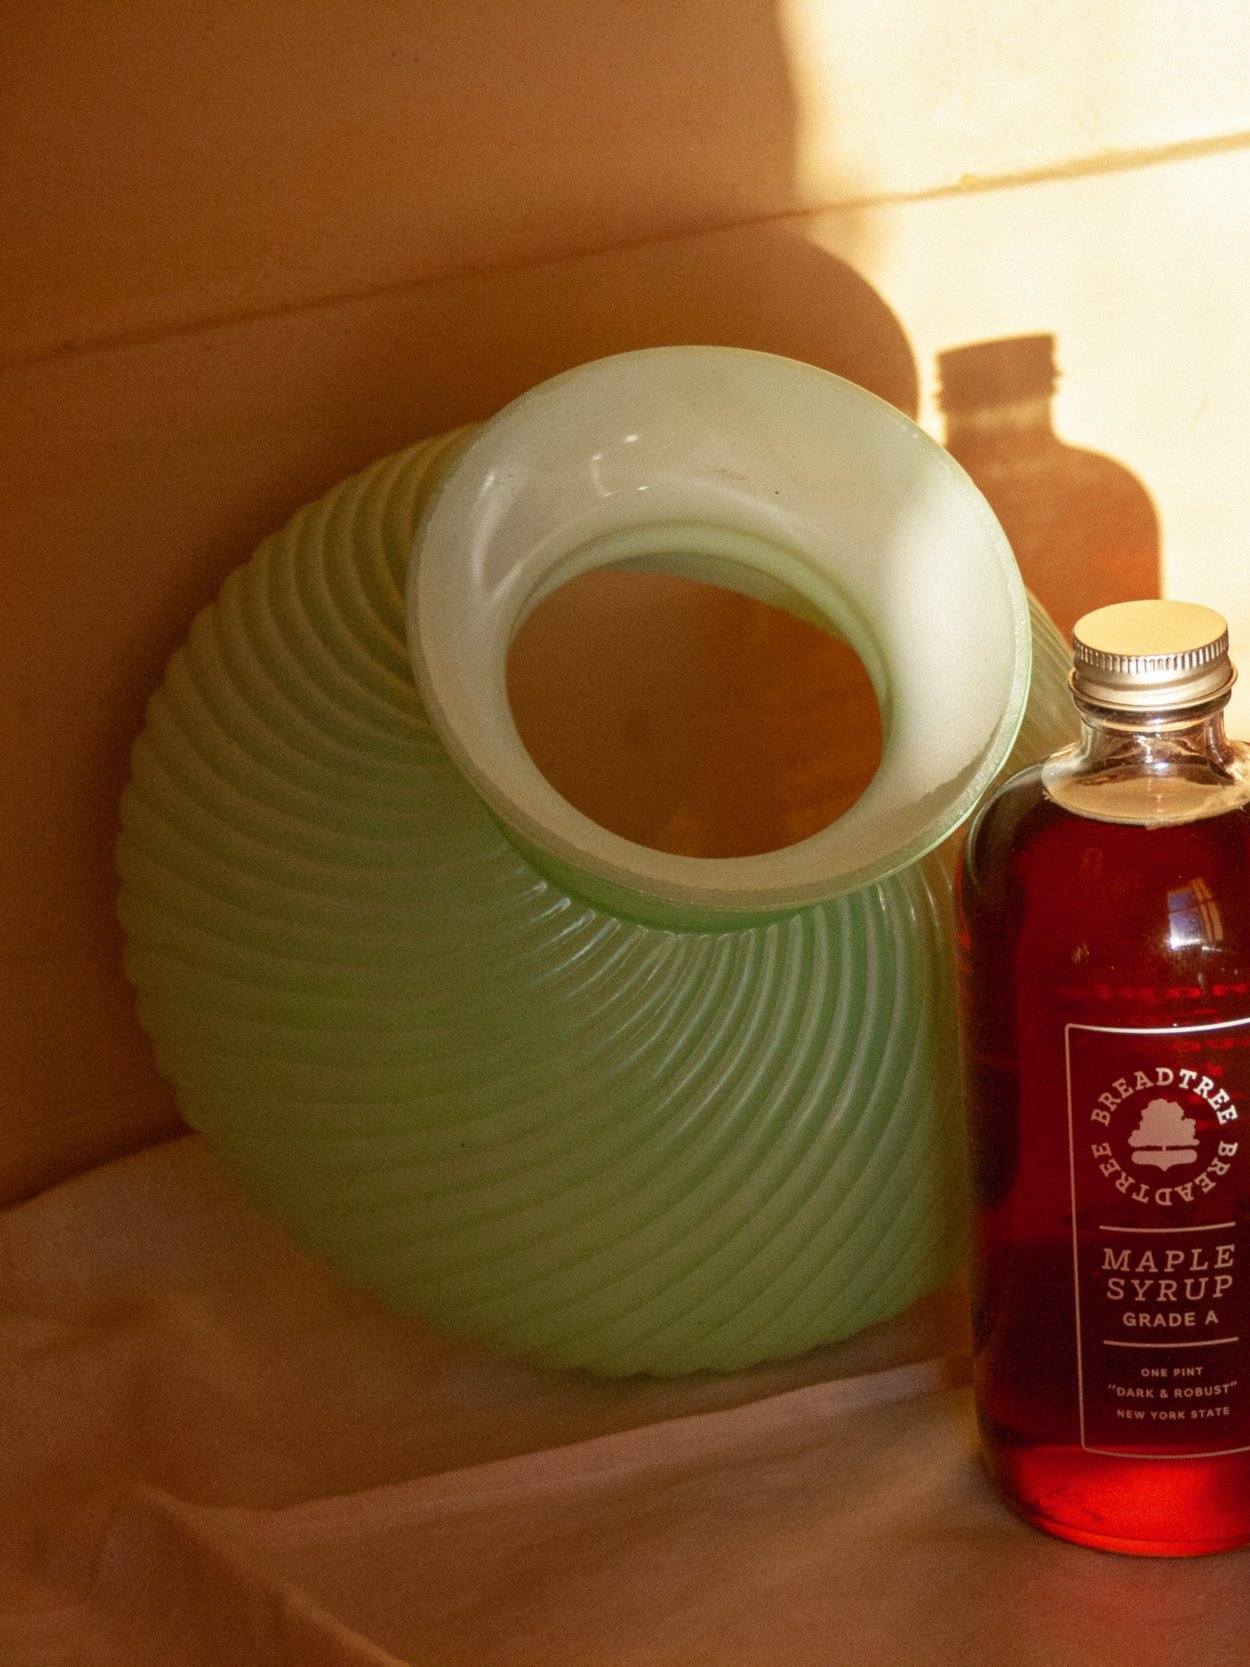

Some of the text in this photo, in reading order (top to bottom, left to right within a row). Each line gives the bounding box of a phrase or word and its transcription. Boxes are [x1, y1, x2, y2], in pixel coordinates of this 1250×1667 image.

[1091, 1067, 1238, 1127] BREADTREE
[1091, 1141, 1238, 1206] BREADTREE
[1101, 1243, 1236, 1273] MAPLE
[1106, 1274, 1233, 1302] SYRUP
[1122, 1310, 1219, 1328] GRADE A
[1140, 1366, 1204, 1378] ONE PINT
[1159, 1388, 1169, 1399] &
[1116, 1406, 1230, 1421] NEW YORK STATE
